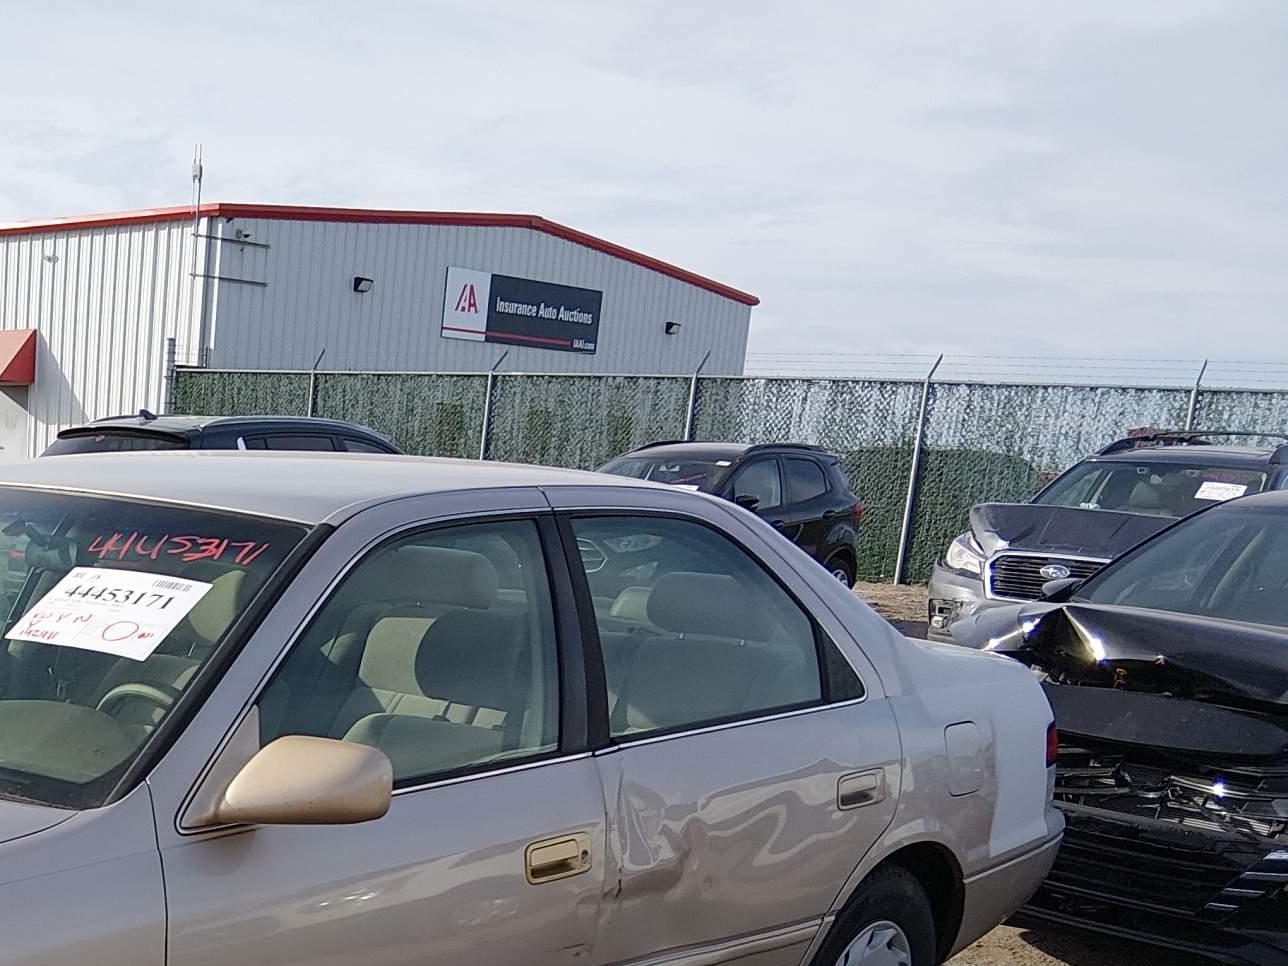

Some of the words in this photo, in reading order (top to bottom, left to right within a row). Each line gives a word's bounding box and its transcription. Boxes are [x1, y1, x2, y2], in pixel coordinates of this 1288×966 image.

[496, 296, 537, 317] Insurance
[538, 303, 557, 319] Auto
[558, 306, 593, 325] Auctions
[65, 585, 175, 610] 44453171
